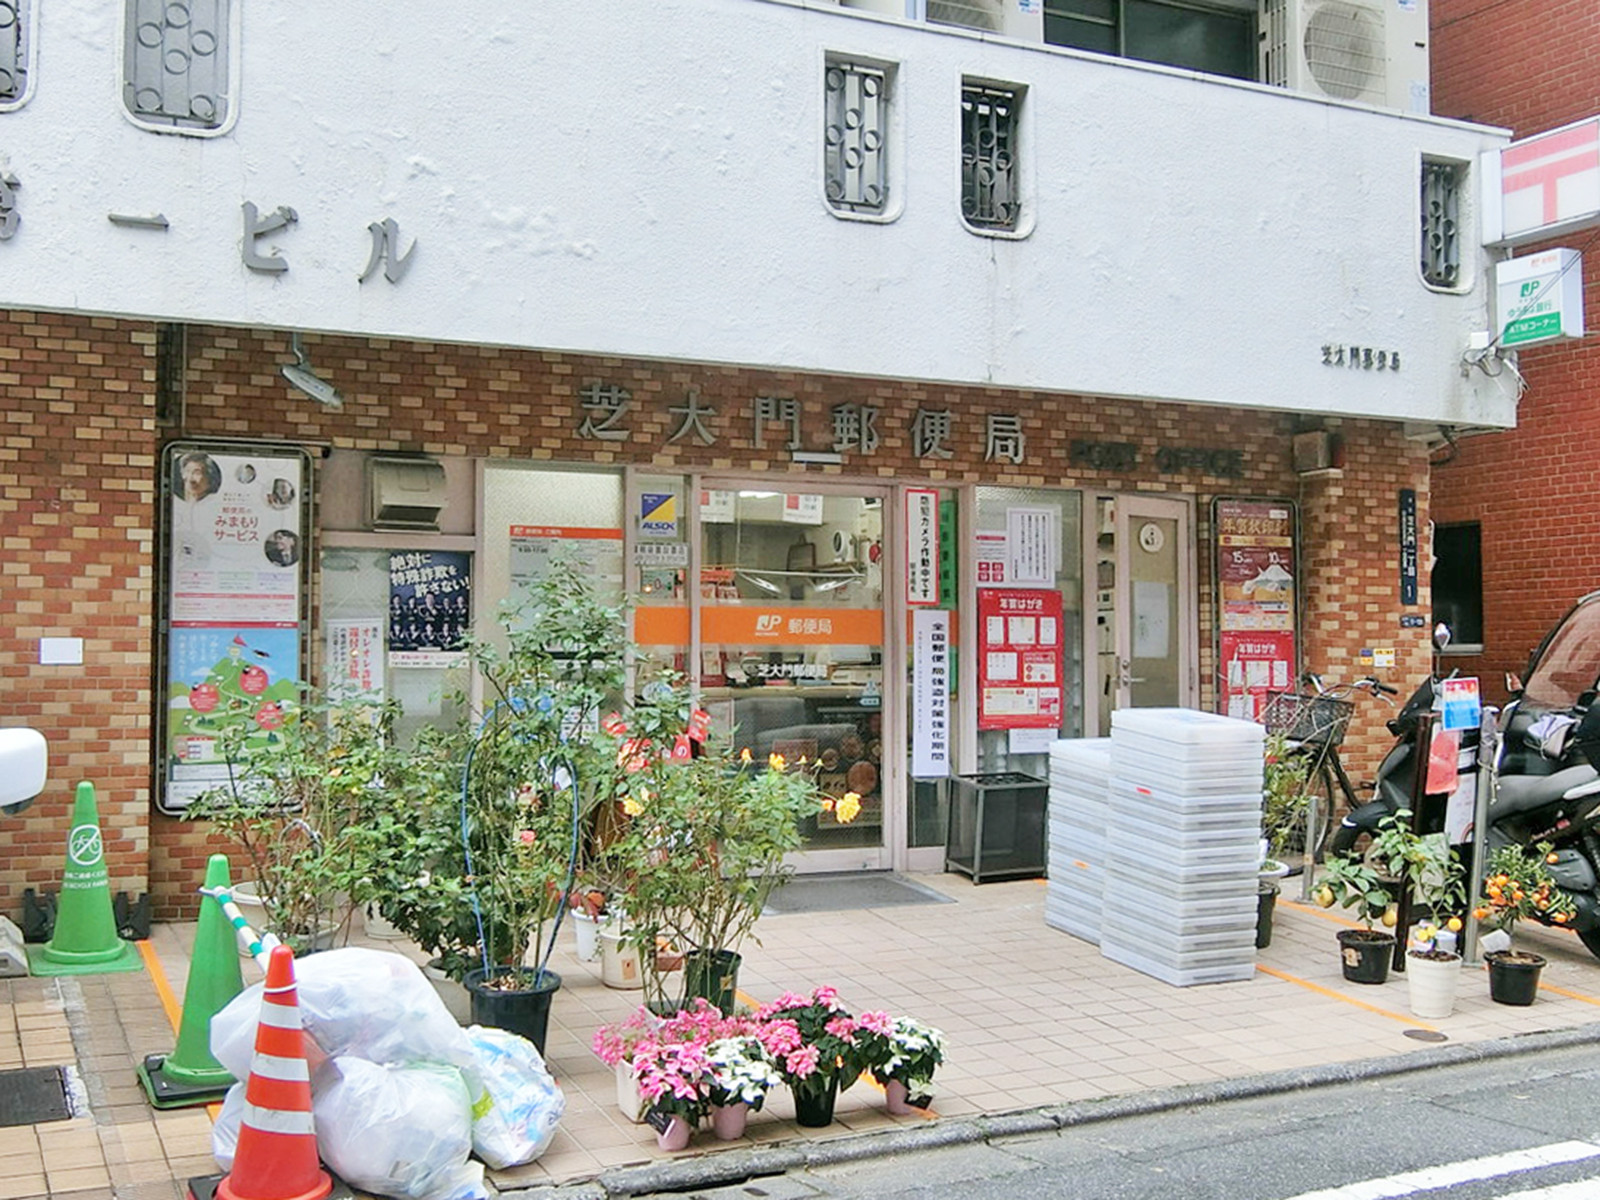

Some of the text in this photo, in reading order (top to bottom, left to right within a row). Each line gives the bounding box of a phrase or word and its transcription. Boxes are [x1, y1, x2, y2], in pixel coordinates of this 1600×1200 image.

[1321, 344, 1400, 372] 芝大門郵便局
[578, 383, 1027, 465] 芝大門郵便局
[214, 515, 259, 529] みまもり
[642, 522, 675, 531] ALSOK
[214, 529, 259, 543] サービス
[389, 552, 432, 571] 絶対に
[390, 565, 458, 587] 特殊詐欺を
[1000, 598, 1043, 610] 年賀はがき
[788, 618, 833, 635] 郵便局
[349, 628, 359, 679] 還付詐欺
[757, 663, 828, 678] 芝大門郵便局
